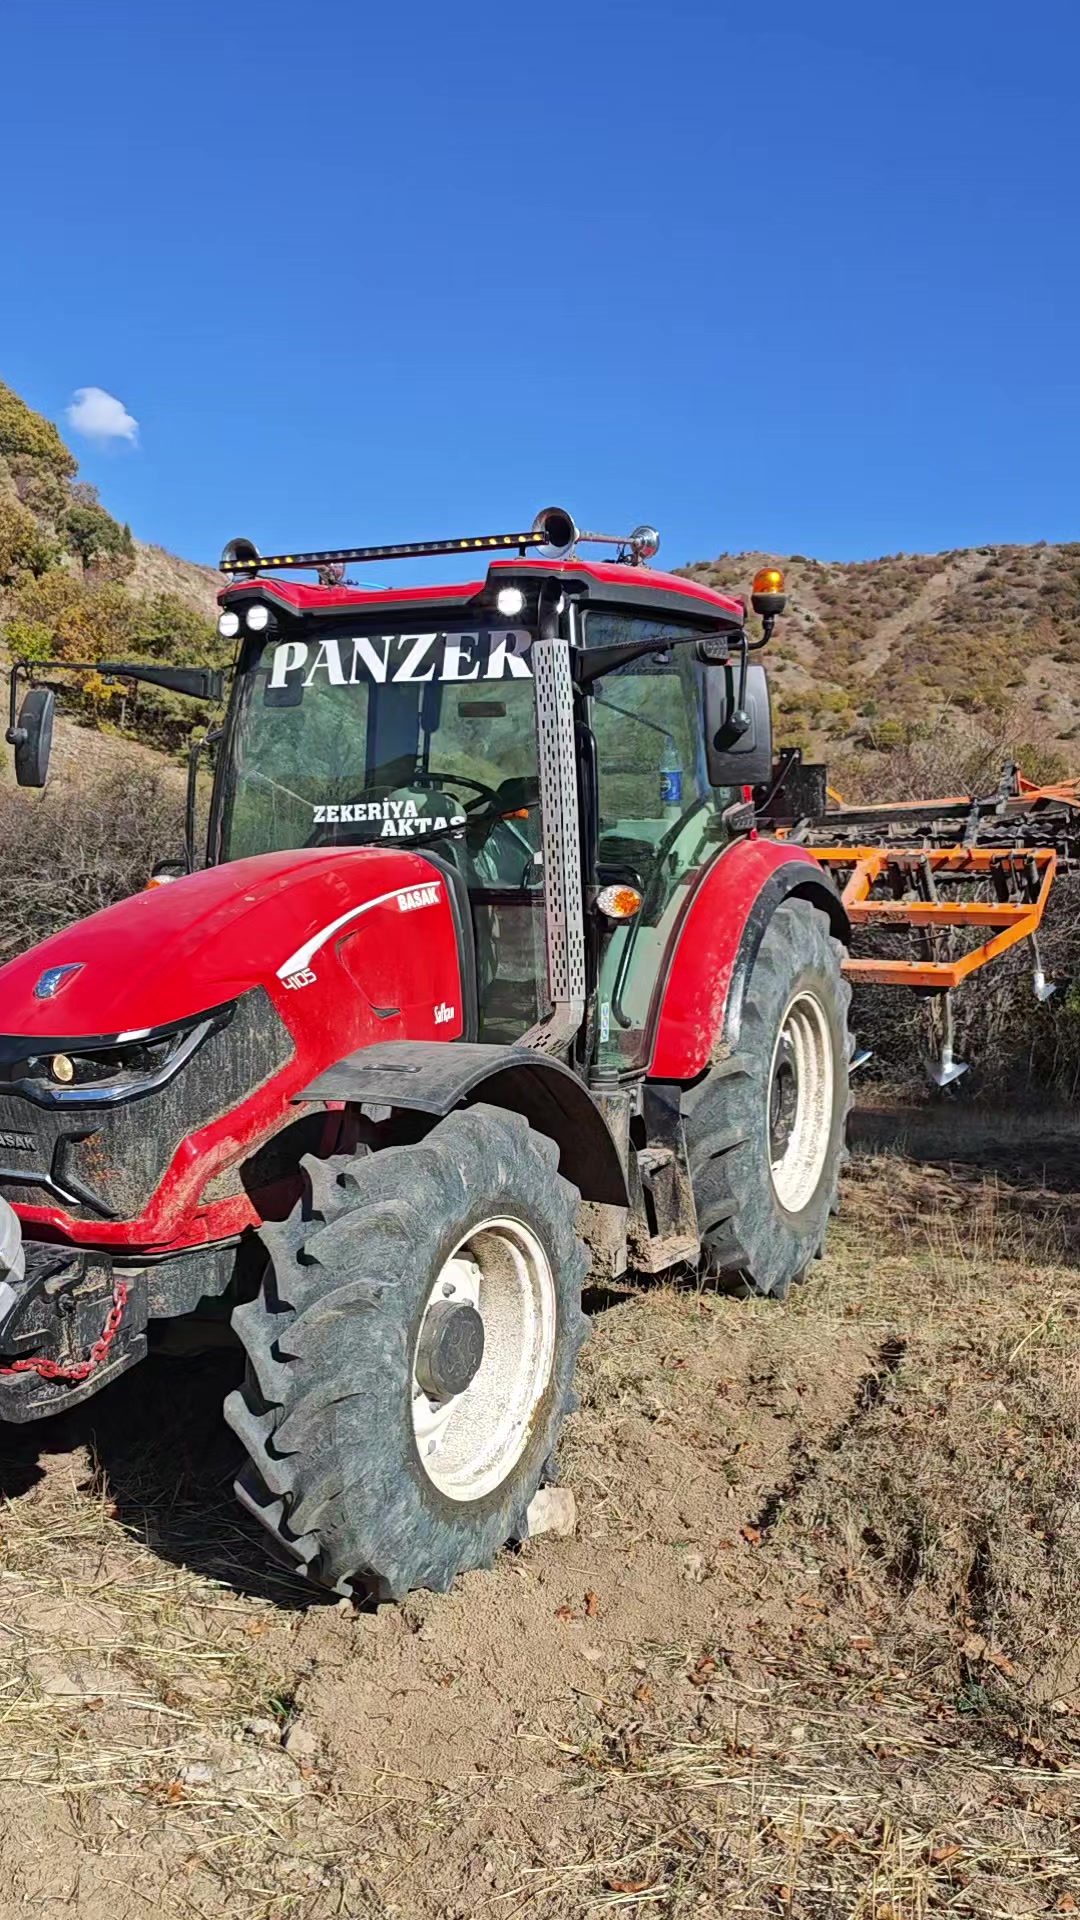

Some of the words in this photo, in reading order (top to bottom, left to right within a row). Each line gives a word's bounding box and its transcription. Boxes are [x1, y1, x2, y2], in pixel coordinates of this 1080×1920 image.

[267, 629, 534, 689] PANZER
[313, 797, 418, 823] ZEKERİYA
[281, 967, 318, 990] 4105
